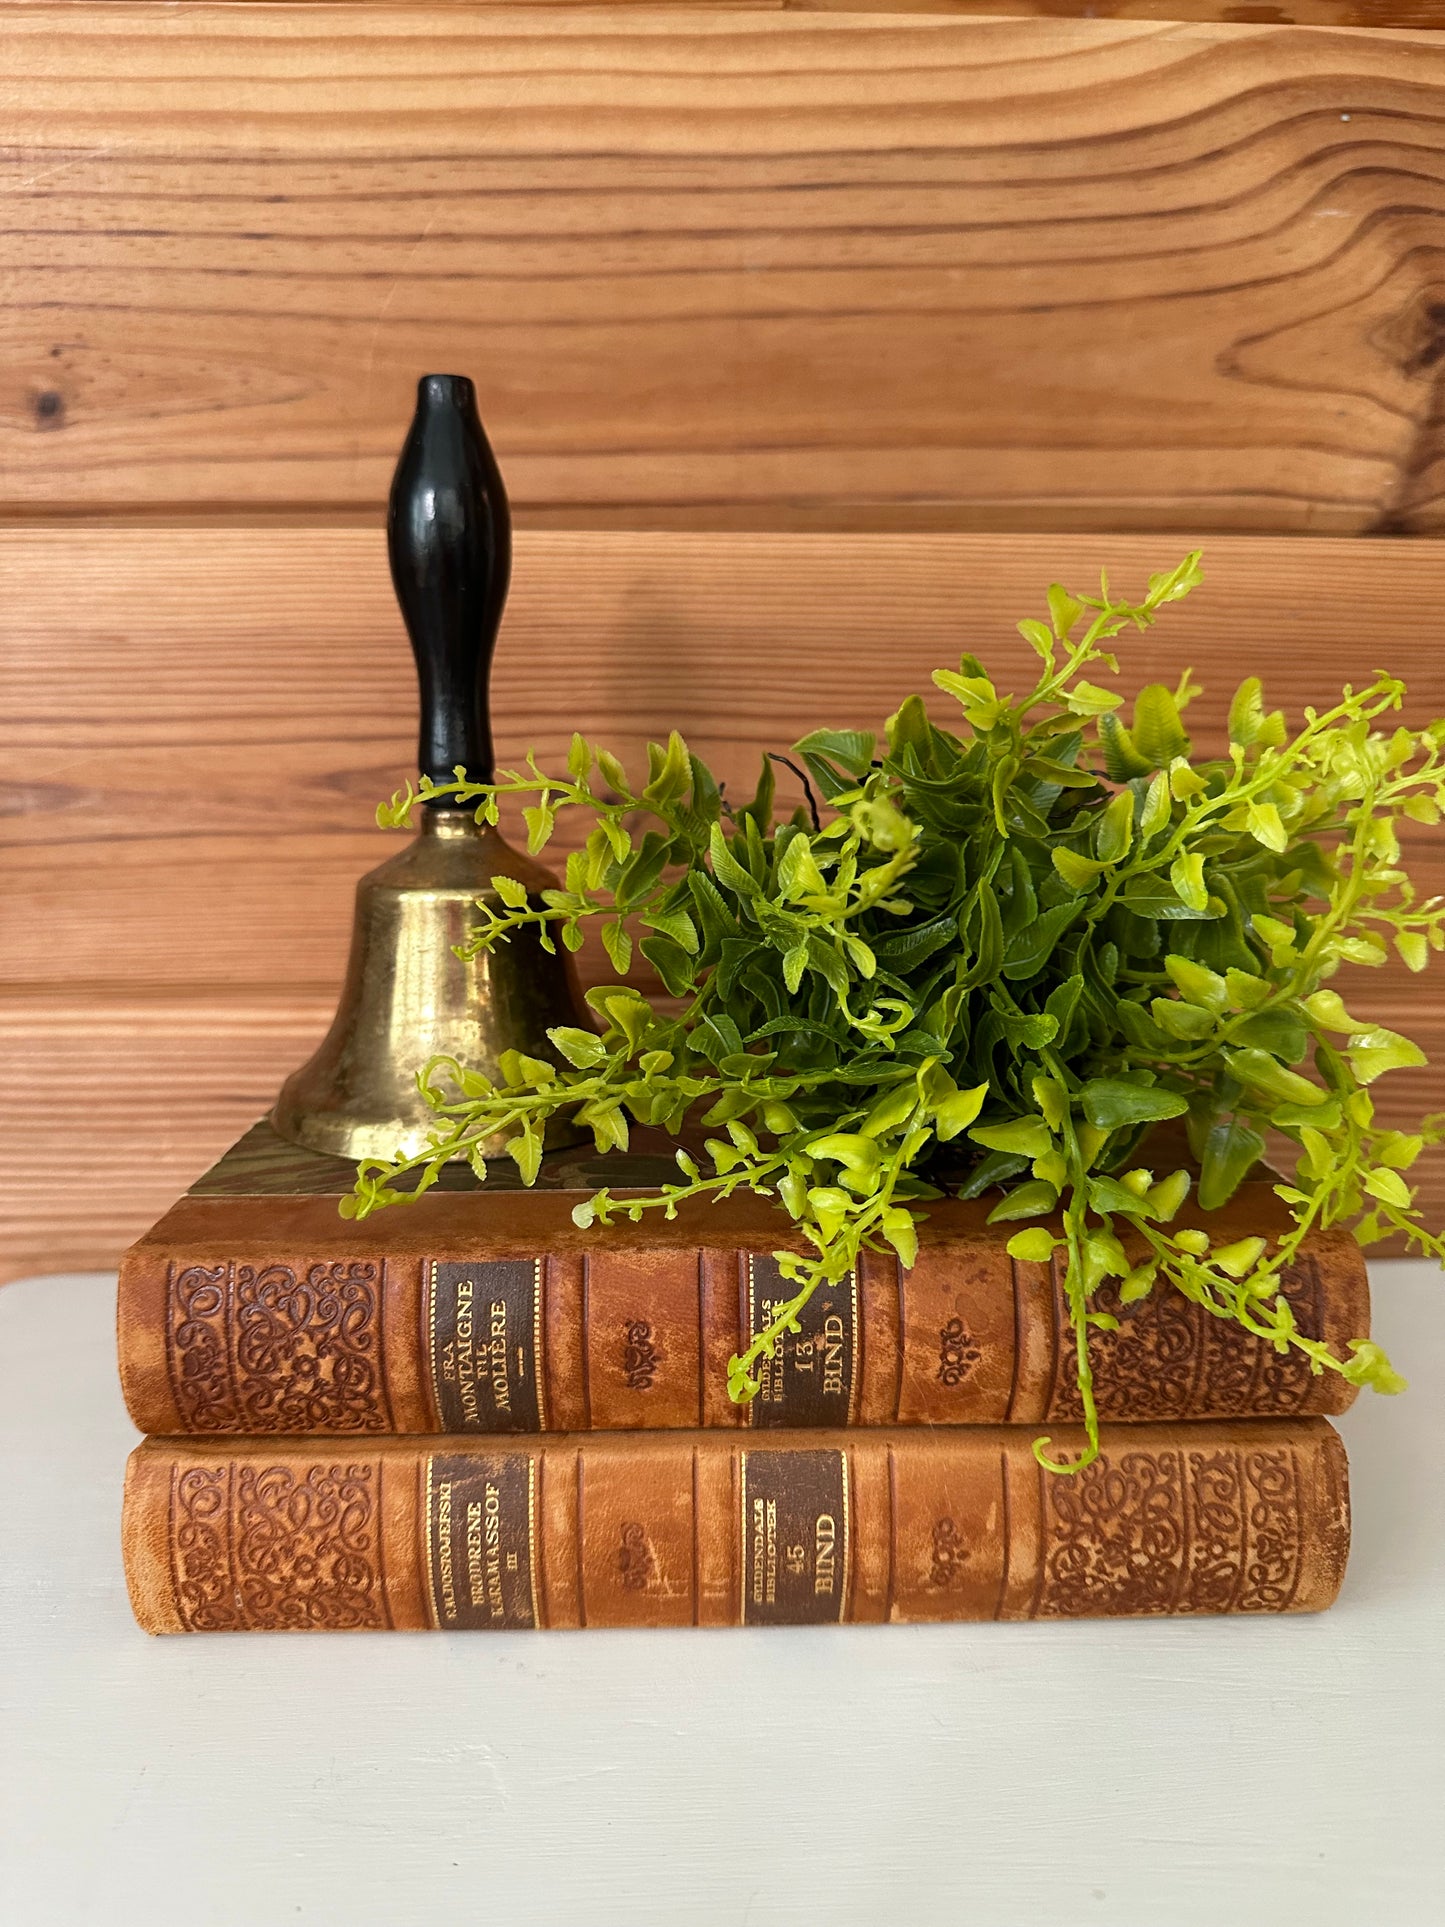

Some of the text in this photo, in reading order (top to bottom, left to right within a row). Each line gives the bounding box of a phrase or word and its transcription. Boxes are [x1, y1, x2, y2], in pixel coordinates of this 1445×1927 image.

[443, 1341, 455, 1381] FRA
[457, 1280, 480, 1423] MONTAIGNE
[476, 1344, 488, 1379] TIL
[488, 1300, 511, 1411] MOLIÈRE
[761, 1299, 771, 1401] GYLDEALS
[774, 1299, 784, 1402] BIBLIOTK
[795, 1341, 814, 1372] 13
[823, 1314, 844, 1394] BIND
[468, 1502, 485, 1607] BRØDRENE
[486, 1482, 504, 1618] KARAMASSOF
[506, 1551, 518, 1571] III
[766, 1498, 777, 1604] BIBLIOTEK
[786, 1544, 804, 1574] 45
[815, 1513, 835, 1594] BIND
